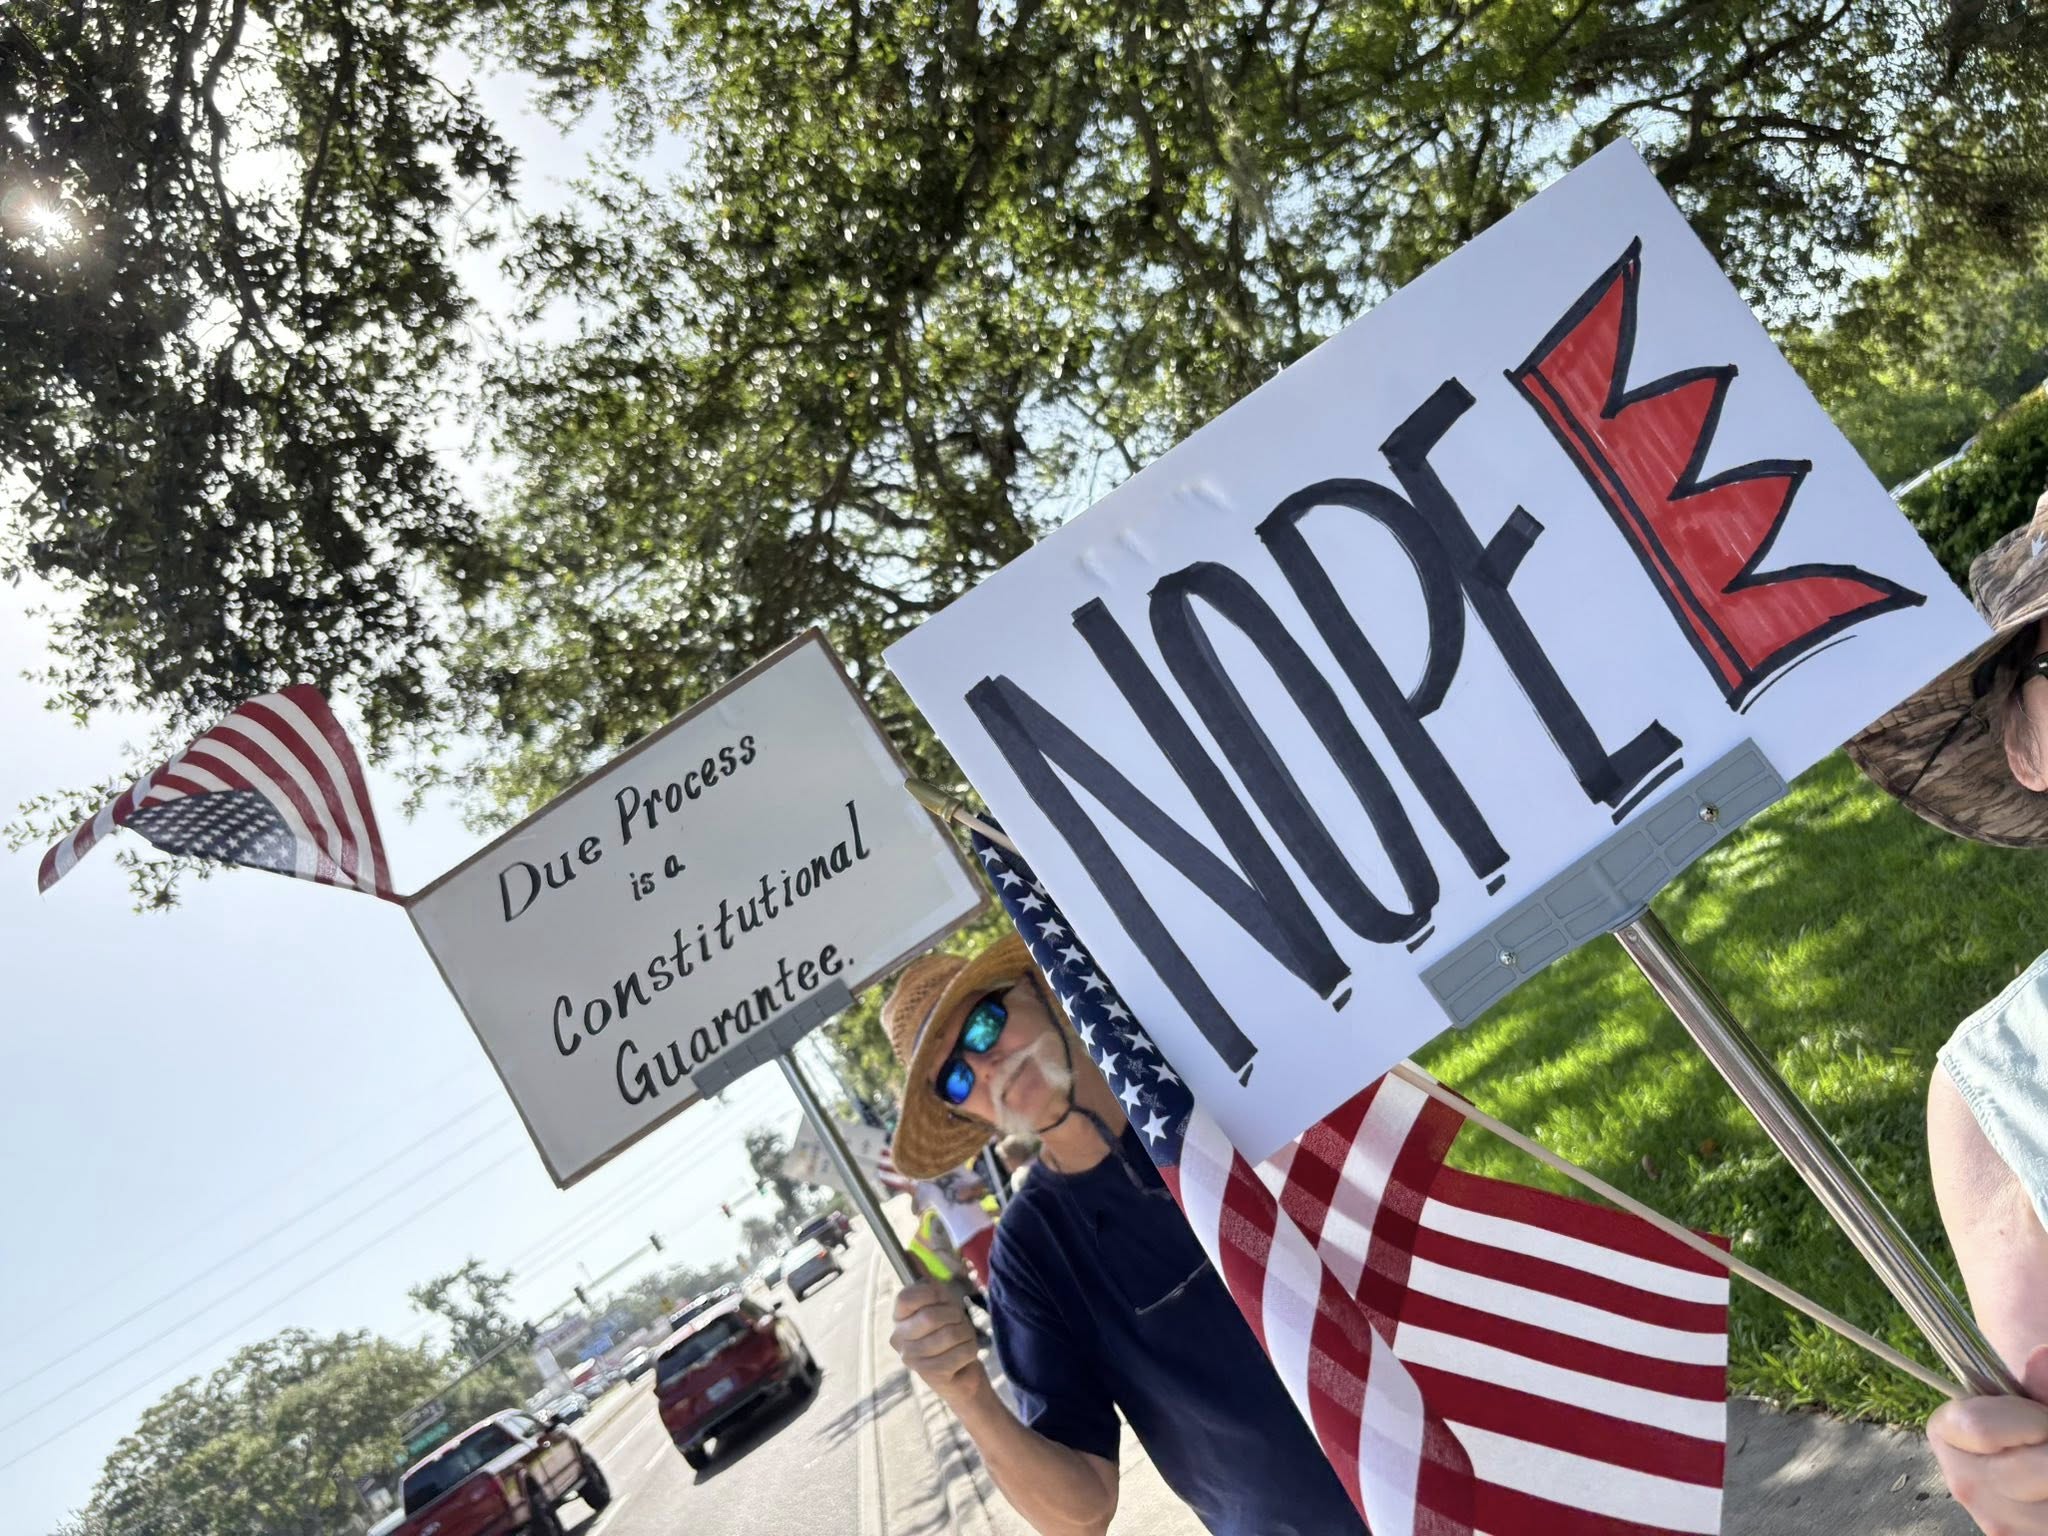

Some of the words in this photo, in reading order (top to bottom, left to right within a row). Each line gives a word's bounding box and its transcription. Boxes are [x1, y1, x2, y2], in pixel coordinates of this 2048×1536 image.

[964, 376, 1684, 1075] NOPE
[497, 836, 604, 923] Due
[614, 735, 757, 846] Process
[630, 871, 656, 902] is
[664, 854, 686, 879] a
[553, 800, 871, 1057] Constitutional
[616, 943, 856, 1106] Guarantee.
